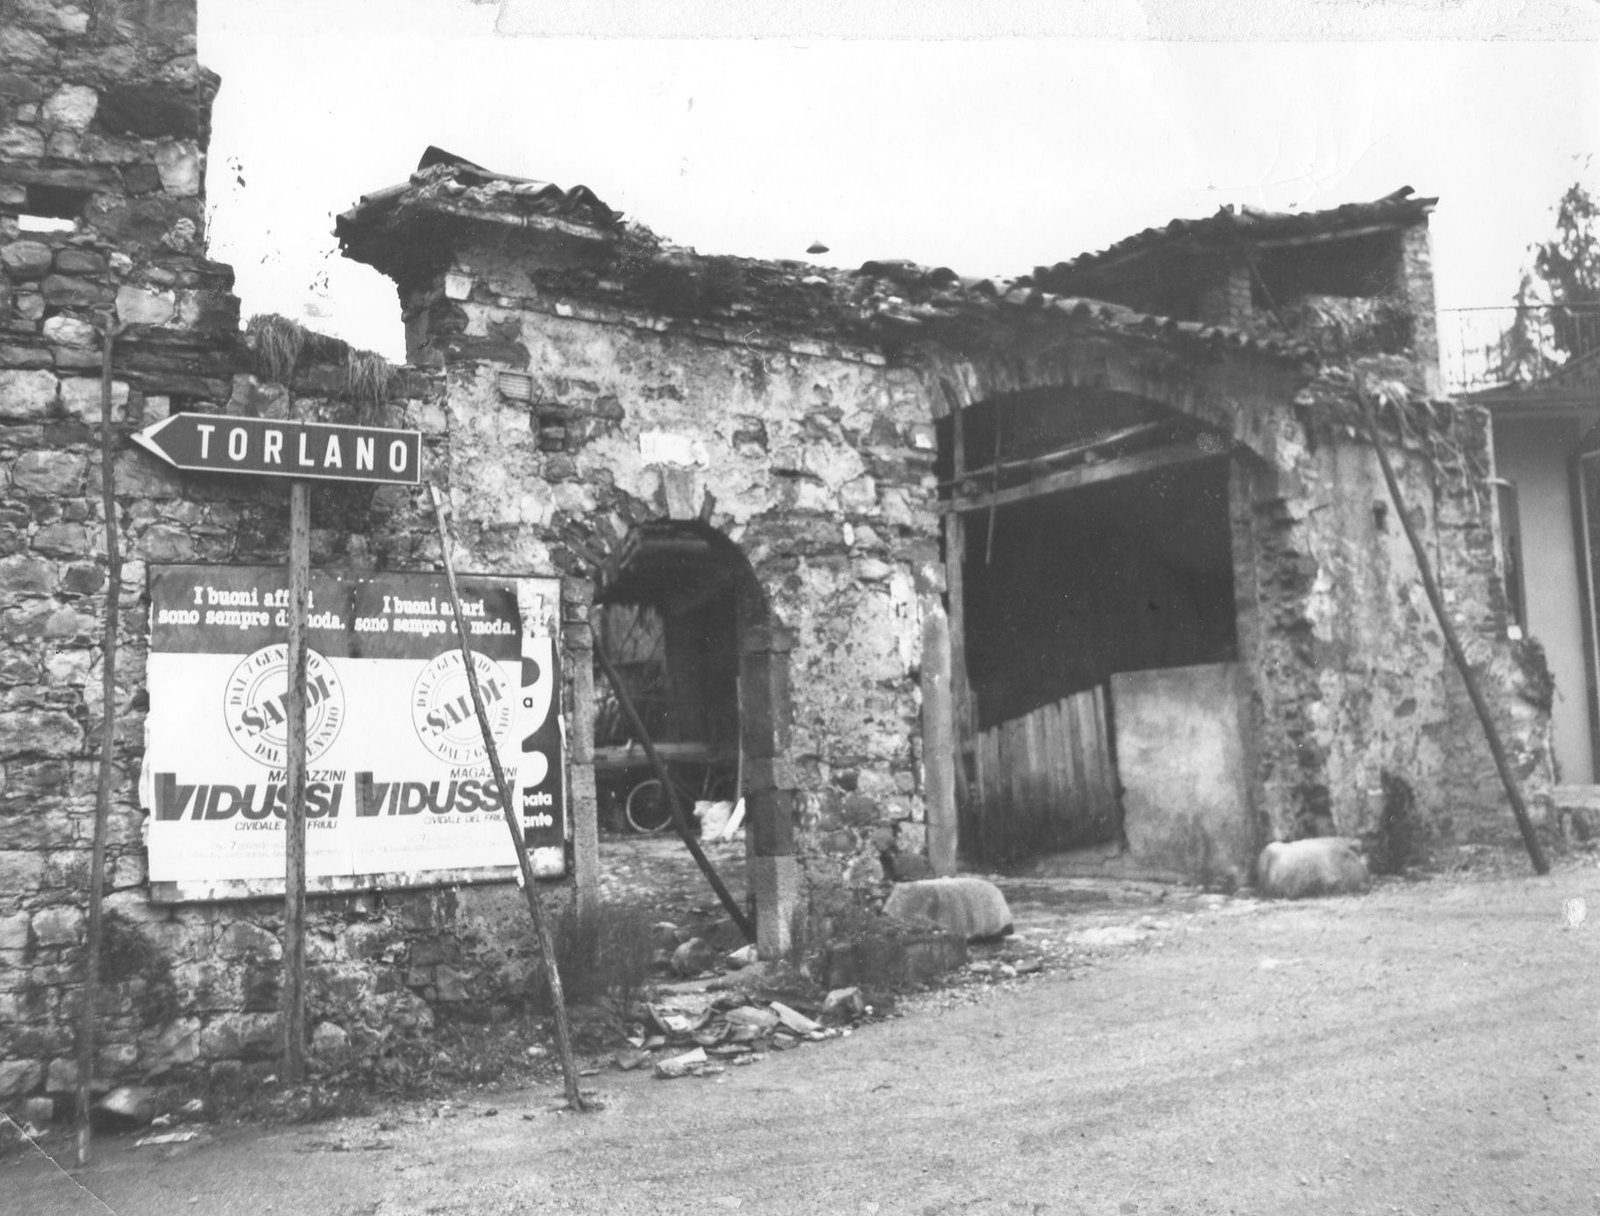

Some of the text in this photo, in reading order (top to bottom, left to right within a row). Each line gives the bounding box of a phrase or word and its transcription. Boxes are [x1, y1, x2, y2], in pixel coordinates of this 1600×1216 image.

[197, 424, 408, 473] TORLANO
[194, 586, 314, 609] I buoni affi
[382, 595, 486, 616] I buoni aari
[158, 609, 200, 624] sono
[205, 610, 270, 630] sempre
[354, 617, 389, 632] sono
[393, 617, 446, 637] sempre
[471, 618, 516, 635] moda.
[243, 661, 253, 674] 7
[255, 646, 320, 669] GENIO
[268, 770, 346, 783] MAAZZINI
[450, 767, 517, 779] MAGAZINI
[235, 820, 281, 831] CIVIDALE
[307, 819, 338, 830] FRIULI
[465, 815, 480, 824] DEL
